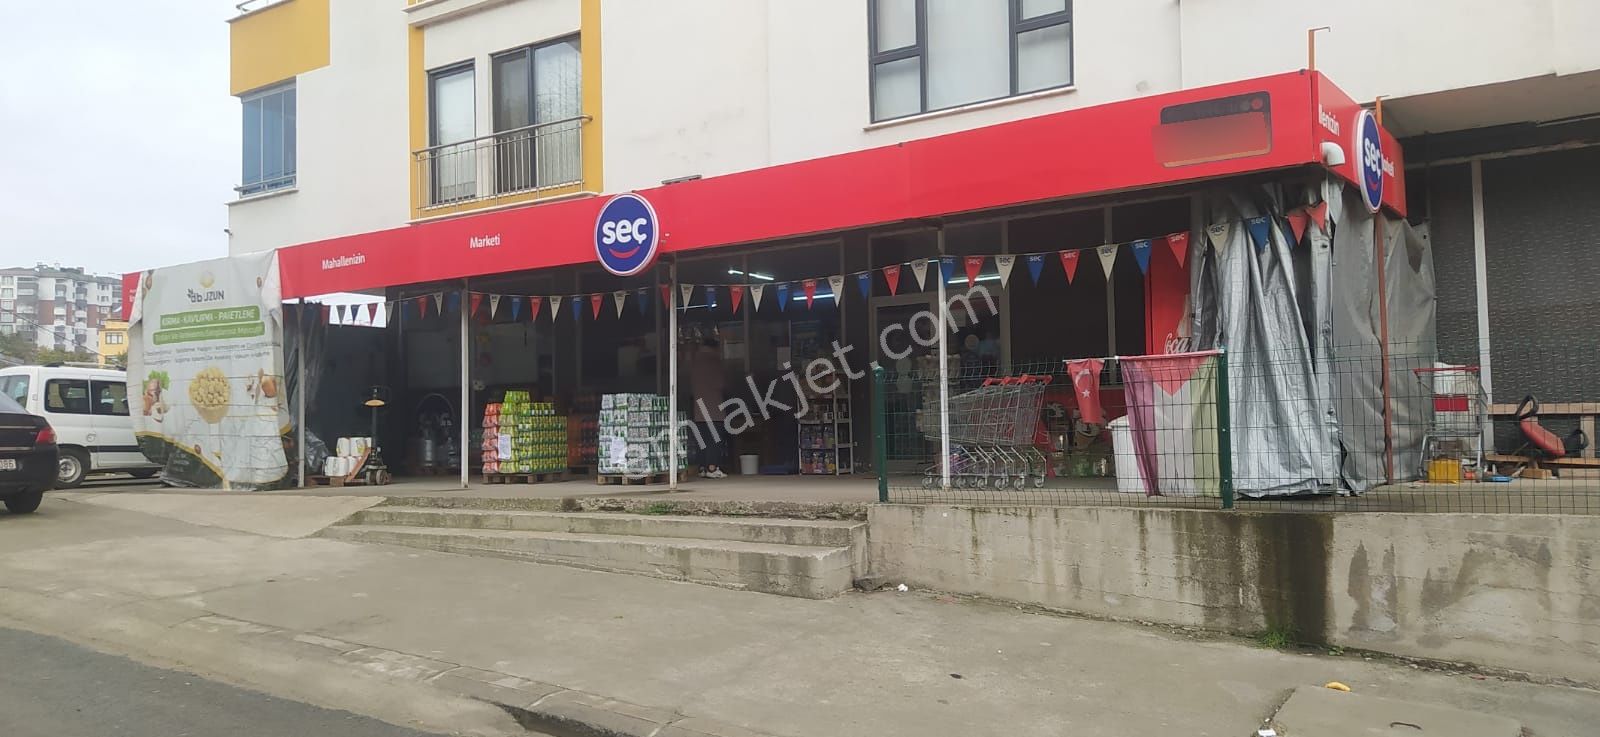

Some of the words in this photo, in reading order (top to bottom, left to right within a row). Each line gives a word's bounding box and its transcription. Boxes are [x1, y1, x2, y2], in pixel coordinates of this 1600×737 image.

[1364, 138, 1381, 179] seç
[469, 233, 501, 249] Marketi
[602, 217, 648, 244] seç
[321, 252, 366, 271] Mahallenizin
